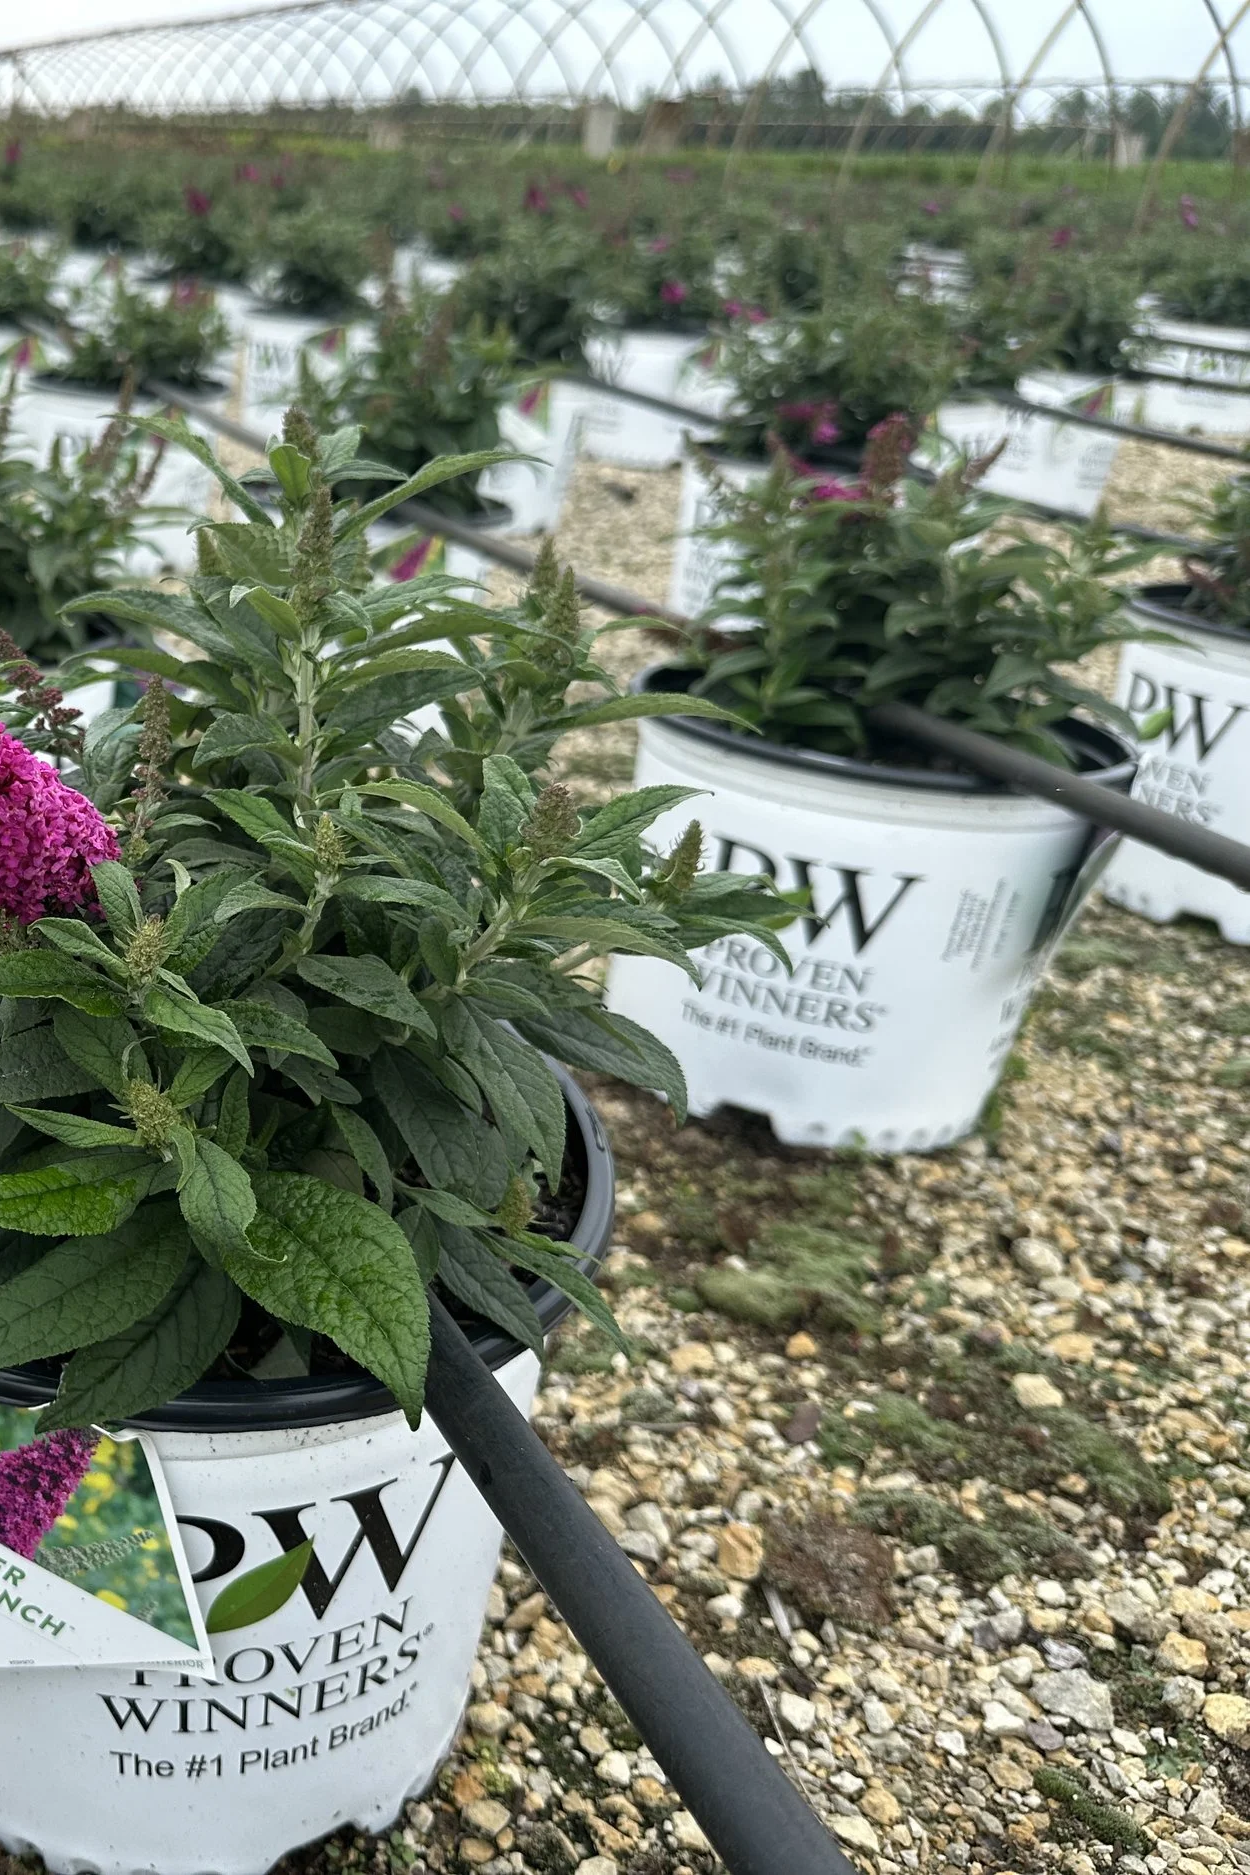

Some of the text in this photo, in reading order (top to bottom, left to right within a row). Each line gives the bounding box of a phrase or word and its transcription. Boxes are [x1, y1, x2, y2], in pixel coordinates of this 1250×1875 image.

[712, 830, 928, 957] PW
[743, 1021, 798, 1057] Plant
[128, 1595, 414, 1688] OVEN
[109, 1749, 175, 1779] The
[184, 1753, 223, 1780] #1
[238, 1735, 320, 1775] Plant
